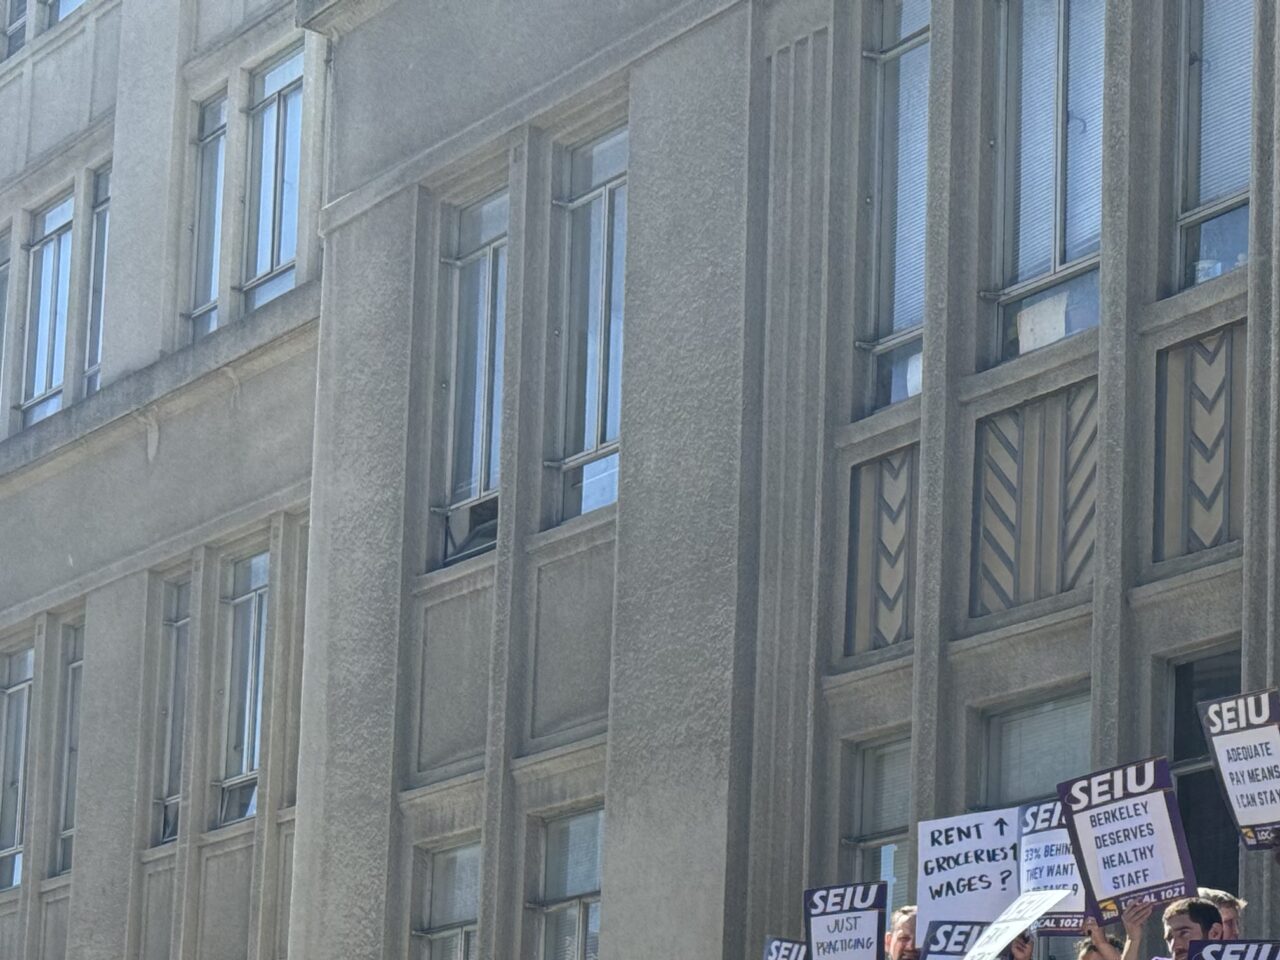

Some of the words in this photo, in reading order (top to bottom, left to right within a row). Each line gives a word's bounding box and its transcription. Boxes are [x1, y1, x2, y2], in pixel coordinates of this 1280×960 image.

[1208, 692, 1270, 734] SEIU
[1226, 741, 1273, 763] ADEQUATE
[1070, 761, 1155, 812] SEIU
[1228, 771, 1247, 787] PAY
[1248, 765, 1280, 783] MEANS
[1240, 792, 1257, 808] CAN
[1089, 800, 1149, 828] BERKELEY
[930, 822, 985, 848] RENT
[1095, 823, 1155, 850] DESERVES
[923, 847, 1009, 877] GROCERIES
[1024, 845, 1042, 862] 33%
[1102, 845, 1155, 870] HEALTHY
[1026, 866, 1046, 883] THEY
[1046, 862, 1076, 881] WANT
[1112, 868, 1150, 890] STAFF
[811, 884, 879, 915] SEIU
[1160, 885, 1186, 900] 1021
[826, 915, 863, 934] JUST
[1059, 917, 1085, 929] 1021
[815, 937, 875, 957] PRACTICING
